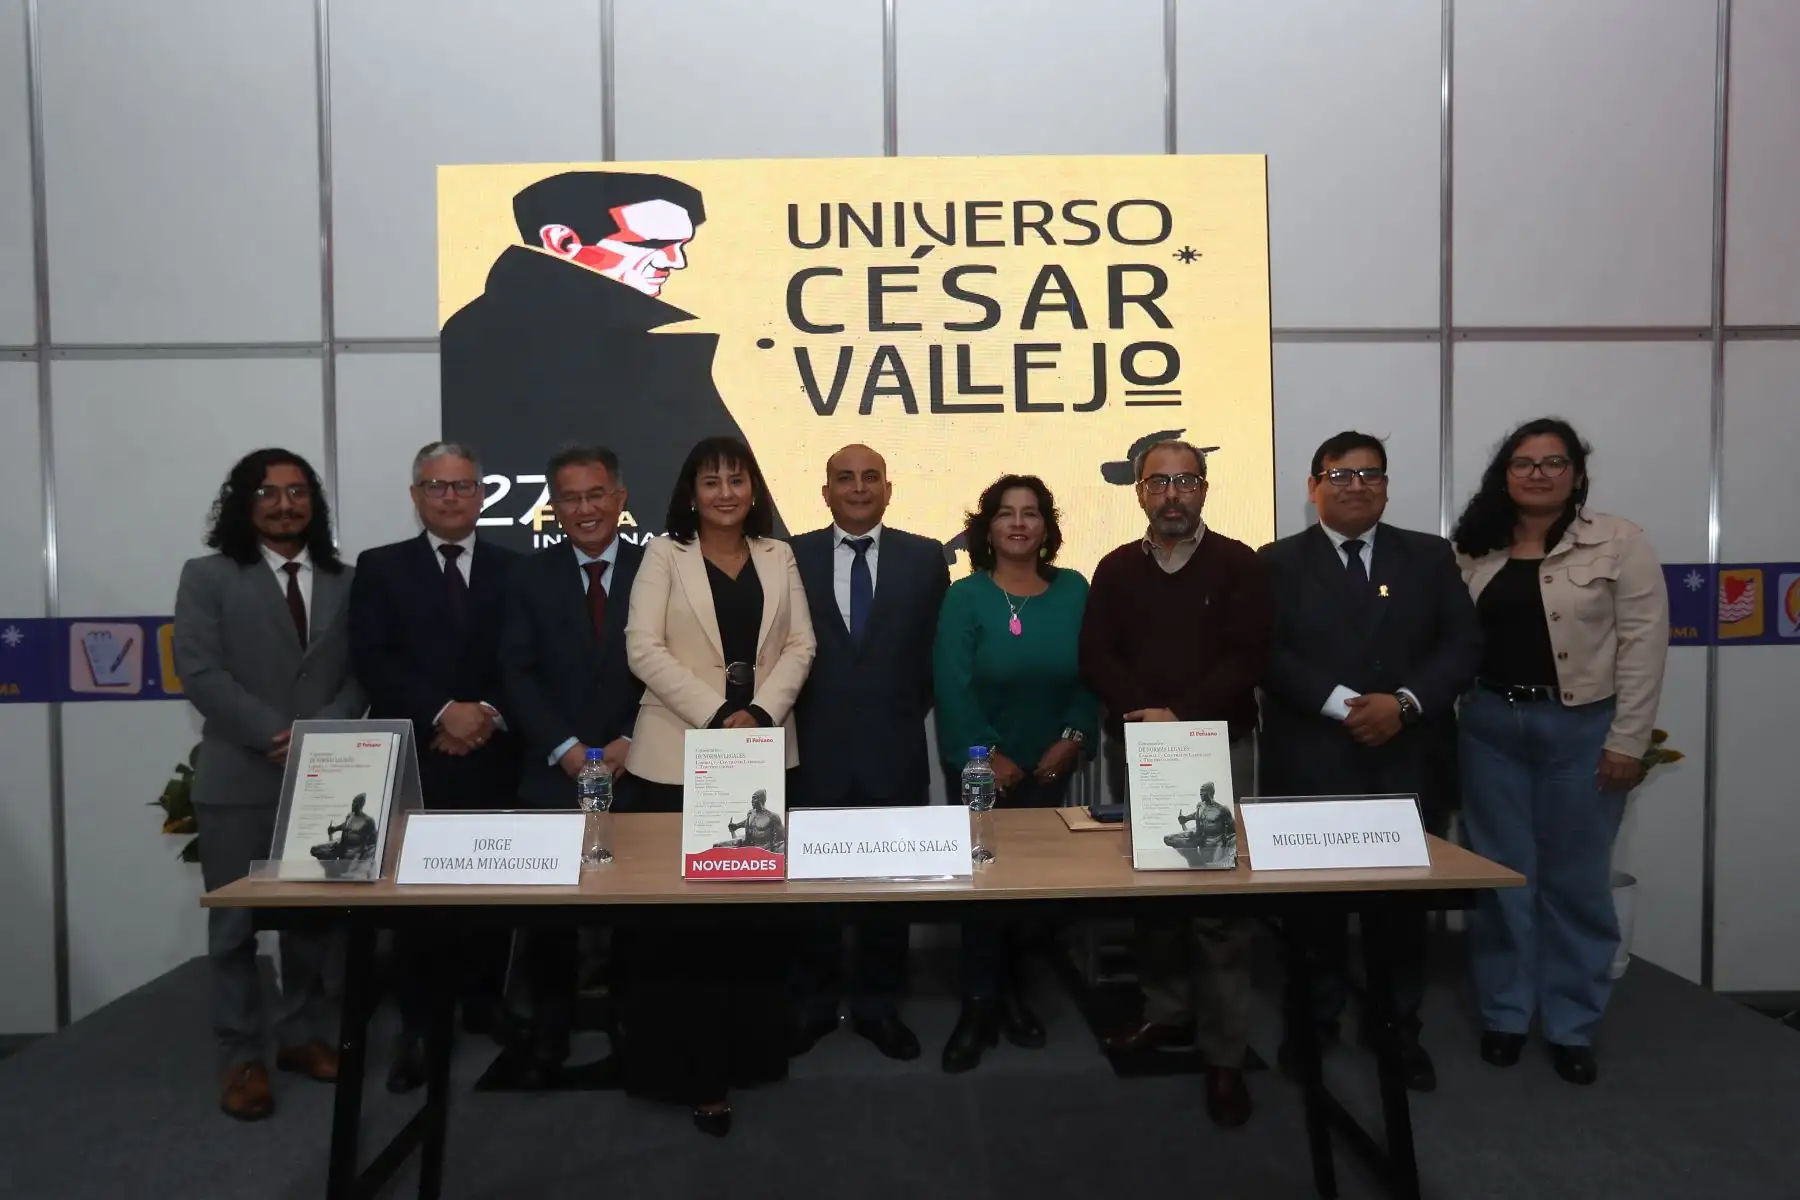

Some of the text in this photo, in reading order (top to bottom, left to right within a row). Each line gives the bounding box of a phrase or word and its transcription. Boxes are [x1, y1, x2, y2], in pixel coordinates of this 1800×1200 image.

[787, 199, 1173, 250] UNIVERSO
[785, 244, 1174, 334] CÉSAR
[793, 340, 1182, 416] VALLEJO
[473, 838, 512, 853] JORGE
[802, 838, 958, 855] MAGALY ALARCÓN SALAS
[1272, 831, 1401, 847] MIGUEL JUAPE PINTO
[423, 857, 559, 870] TOYAMA MIYAGUSUKU
[692, 860, 777, 871] NOVEDADES
